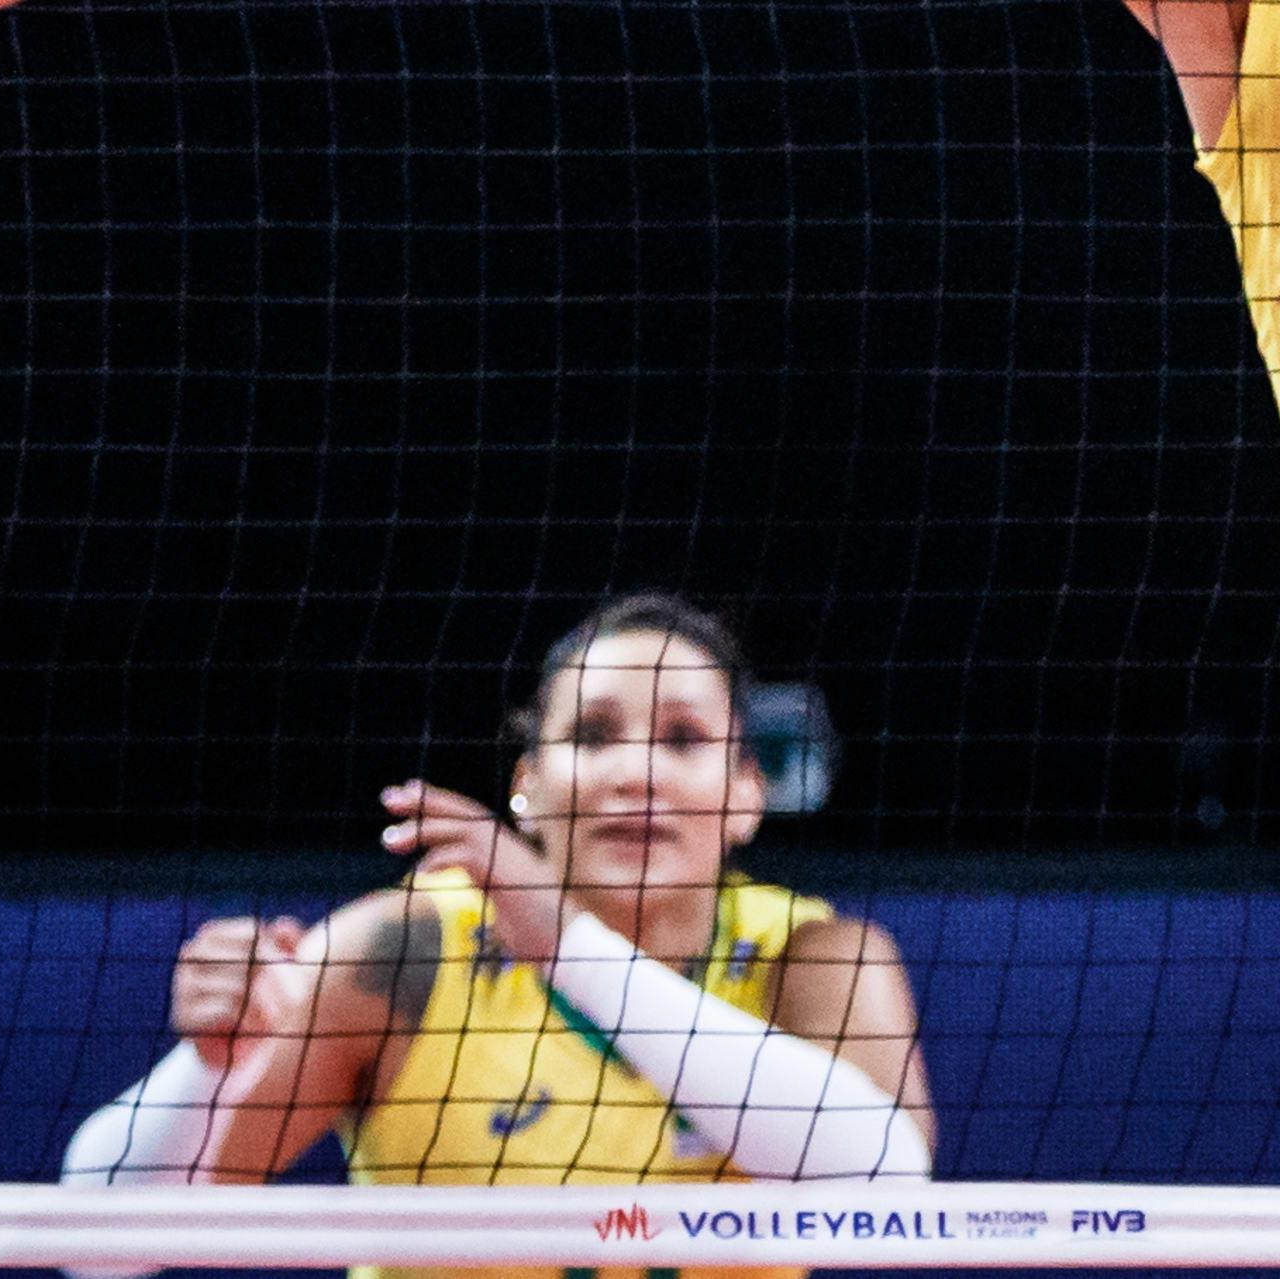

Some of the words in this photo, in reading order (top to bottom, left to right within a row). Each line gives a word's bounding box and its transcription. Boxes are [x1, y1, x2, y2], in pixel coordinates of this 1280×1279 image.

[679, 1208, 957, 1239] VOLLEYBALL
[966, 1210, 1048, 1224] NATIONS
[1072, 1209, 1147, 1234] FIVB
